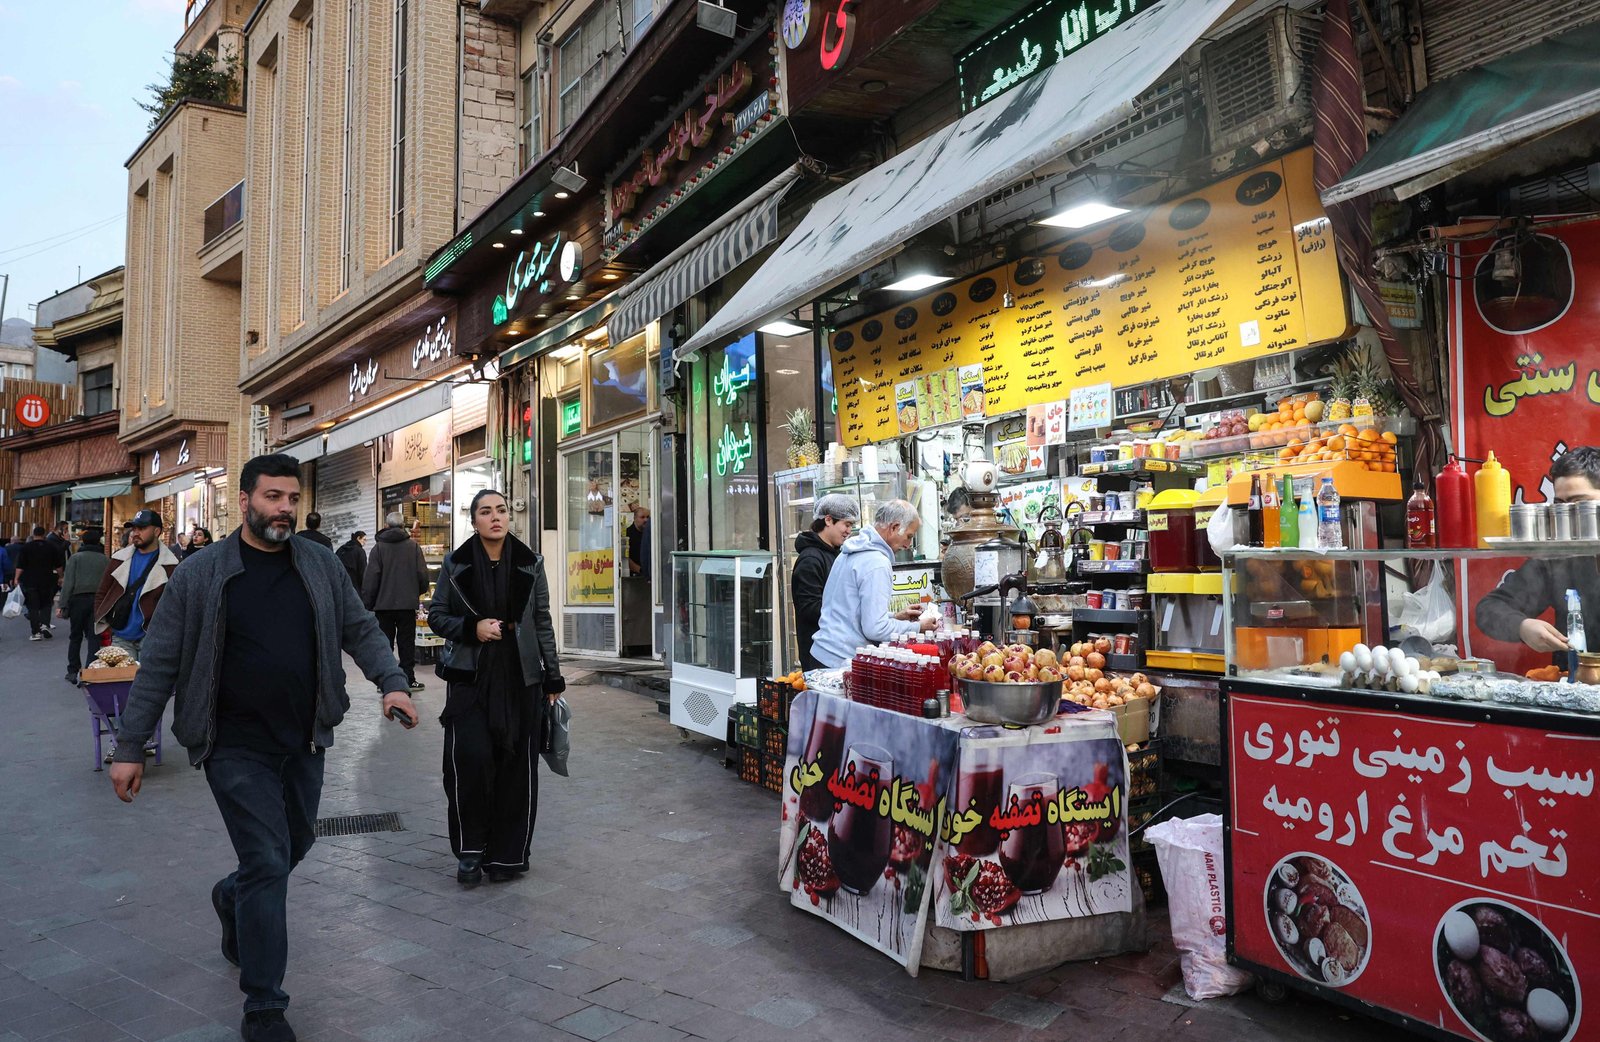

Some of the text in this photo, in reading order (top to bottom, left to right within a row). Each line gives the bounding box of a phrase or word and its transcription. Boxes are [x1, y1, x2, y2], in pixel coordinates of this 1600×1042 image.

[1252, 211, 1276, 224] پرتقال
[1257, 239, 1277, 250] هویج
[1178, 256, 1215, 273] هویج کرفس
[1257, 252, 1282, 264] زرشک
[506, 242, 541, 310] مهدی
[1183, 269, 1215, 285] شاتوت انار
[1260, 265, 1281, 280] آلبالو
[1137, 286, 1147, 297] شیر
[1182, 281, 1219, 297] بخارا شاتوت
[1177, 293, 1228, 313] زرشک انار آلبالو
[1255, 292, 1297, 310] توت فرنگی
[1066, 308, 1100, 326] طالبی بستنی
[1121, 302, 1151, 319] شیر طالبی
[1187, 308, 1221, 322] کیوی بخارا
[1265, 309, 1290, 320] شاتوت
[1069, 325, 1104, 343] شاتوت بستنی
[1186, 320, 1226, 336] زرشک آلبالو
[1273, 324, 1287, 333] انبه
[1038, 333, 1054, 343] معجون
[1186, 338, 1206, 349] پرتقال
[1207, 331, 1228, 344] آناناس
[1266, 338, 1297, 350] هندوانه
[1038, 345, 1054, 355] معجون
[1074, 343, 1102, 359] انار بستنی
[1193, 346, 1225, 361] انار پرتقال
[1042, 357, 1050, 366] شیر
[1075, 363, 1106, 377] سیب بستنی
[1484, 352, 1576, 416] سنتی
[1243, 717, 1595, 808] سیب زمینی تنوری
[826, 760, 880, 814] تصفیه
[990, 791, 1042, 837] تصفیه
[1047, 786, 1121, 828] ایستگاه
[1262, 784, 1568, 878] تخم مرغ ارومیه
[1207, 873, 1222, 913] PLASTIC
